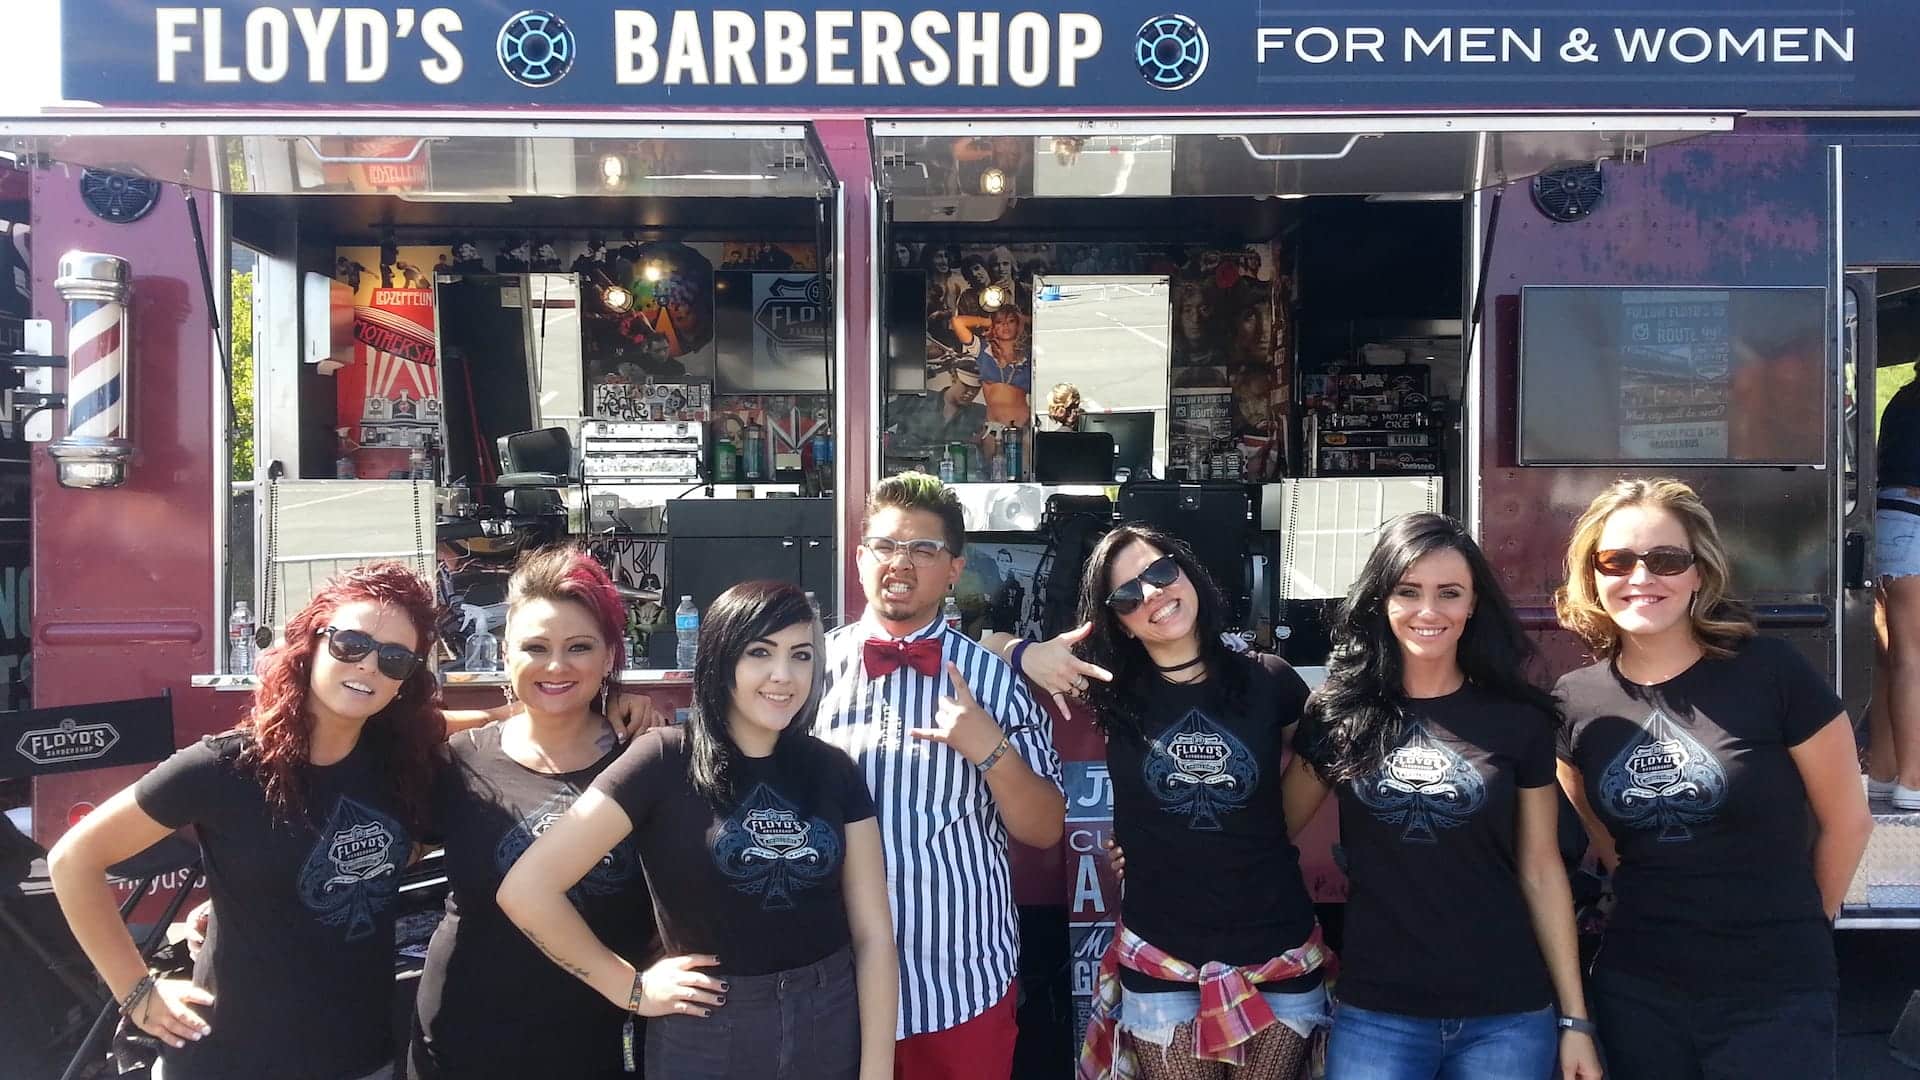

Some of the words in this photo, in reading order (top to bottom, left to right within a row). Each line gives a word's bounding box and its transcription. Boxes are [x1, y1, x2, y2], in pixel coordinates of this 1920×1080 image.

[156, 7, 464, 84] FLOYD'S
[614, 9, 1103, 88] BARBERSHOP
[1256, 26, 1385, 63] FOR
[1404, 27, 1542, 63] MEN
[1559, 28, 1599, 63] &
[1615, 26, 1855, 63] WOMEN
[31, 730, 105, 755] FLOYD'S
[1176, 745, 1222, 757] FLOYD'S
[752, 820, 802, 832] FLOYD'S
[337, 835, 385, 860] FLOYD'S
